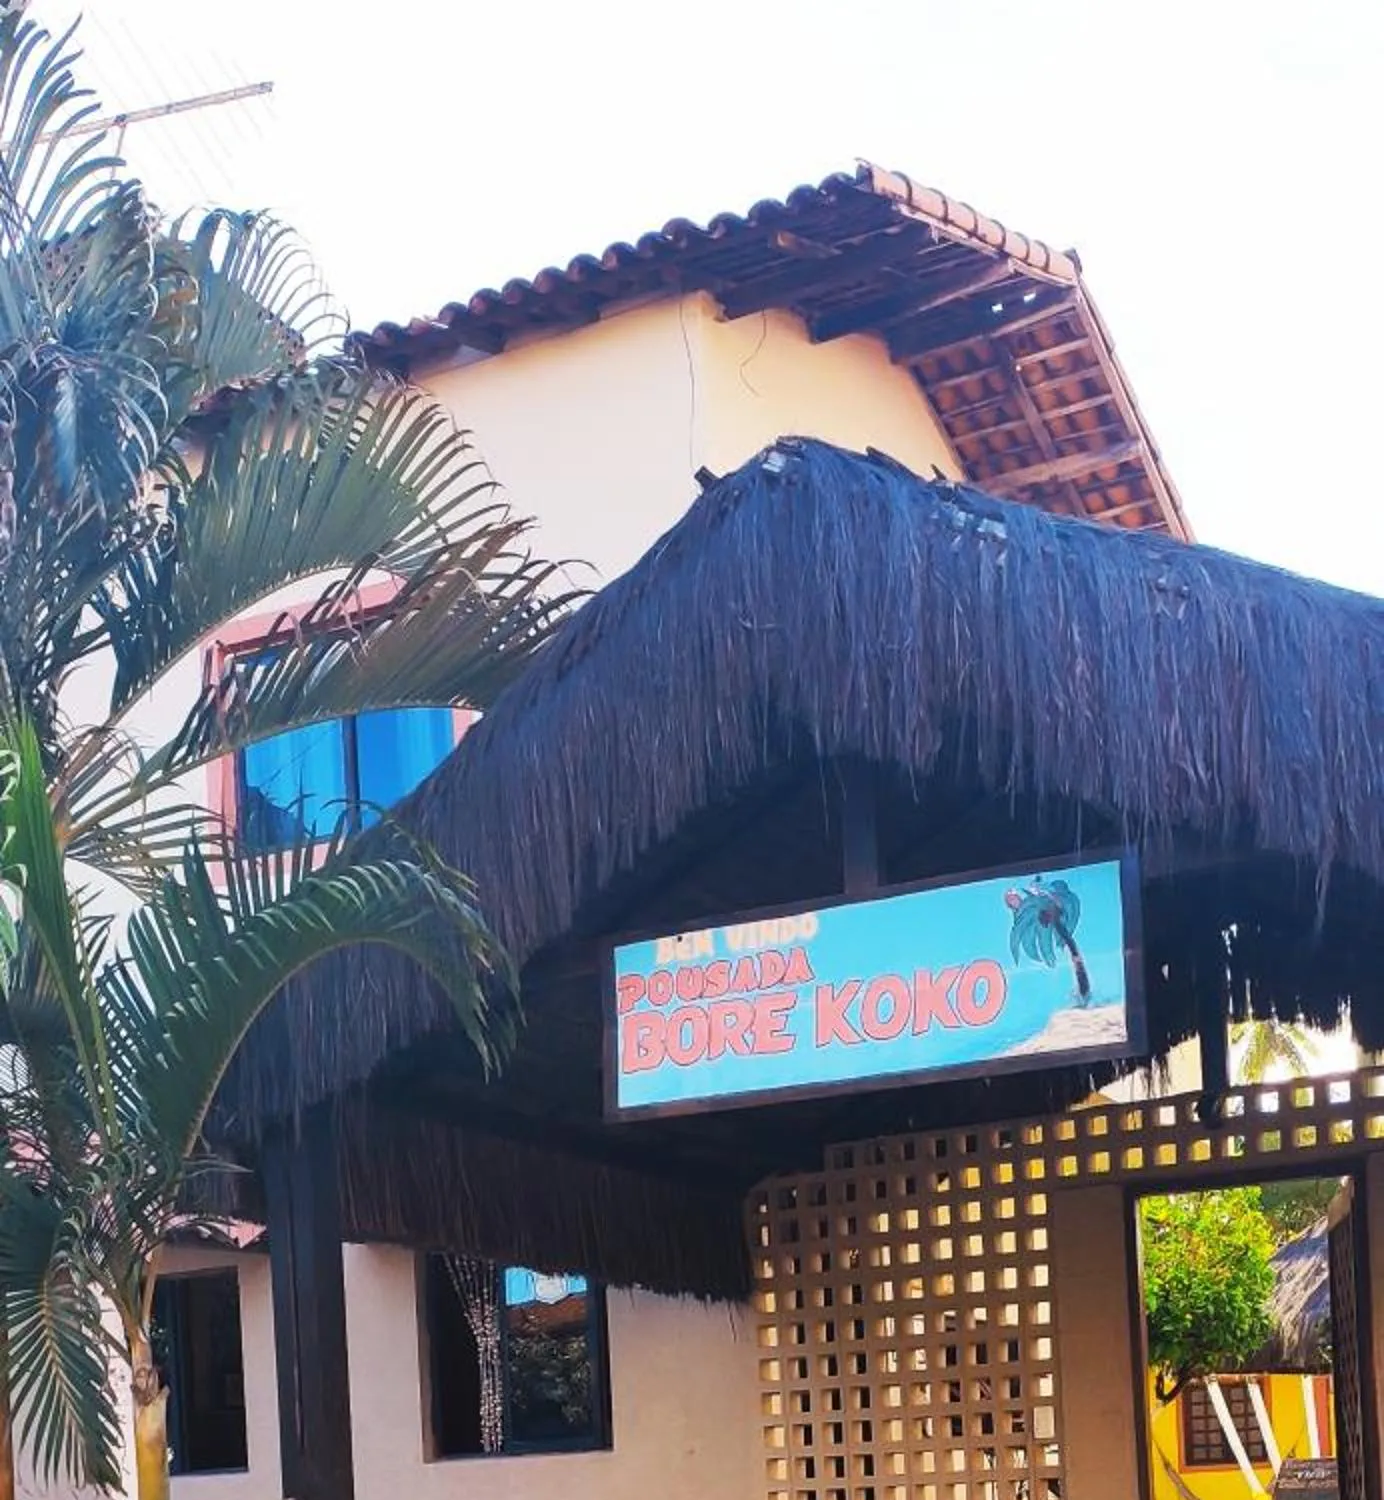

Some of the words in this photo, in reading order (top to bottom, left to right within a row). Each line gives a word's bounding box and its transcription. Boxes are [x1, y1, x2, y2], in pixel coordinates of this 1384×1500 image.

[618, 947, 815, 1013] POUSADA
[623, 992, 797, 1074] BORE
[815, 959, 1007, 1048] KOKO
